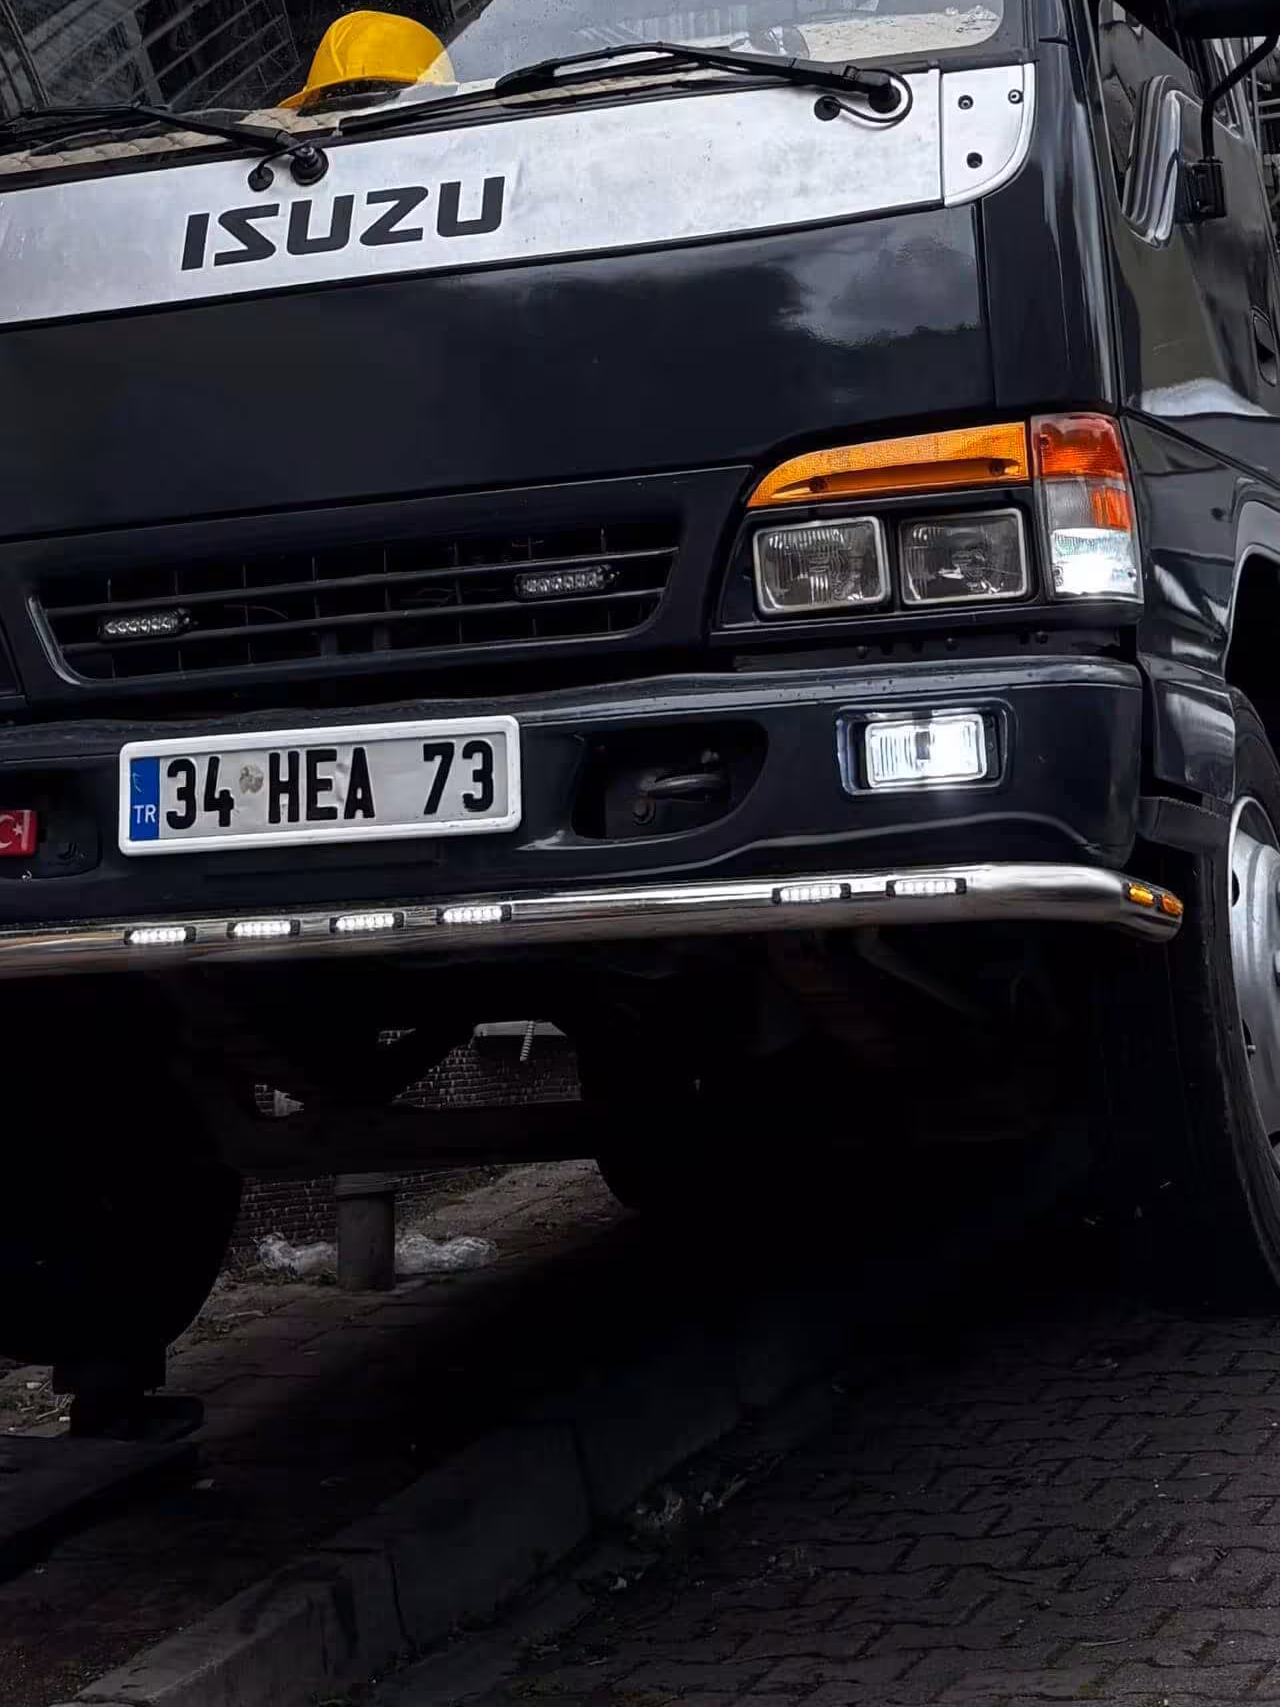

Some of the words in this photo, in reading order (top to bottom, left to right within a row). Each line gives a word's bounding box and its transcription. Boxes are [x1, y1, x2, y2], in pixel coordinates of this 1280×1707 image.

[181, 175, 506, 271] ISUZU
[133, 803, 157, 824] TR
[165, 754, 235, 832] 34
[267, 745, 376, 823] HEA
[422, 738, 496, 817] 73
